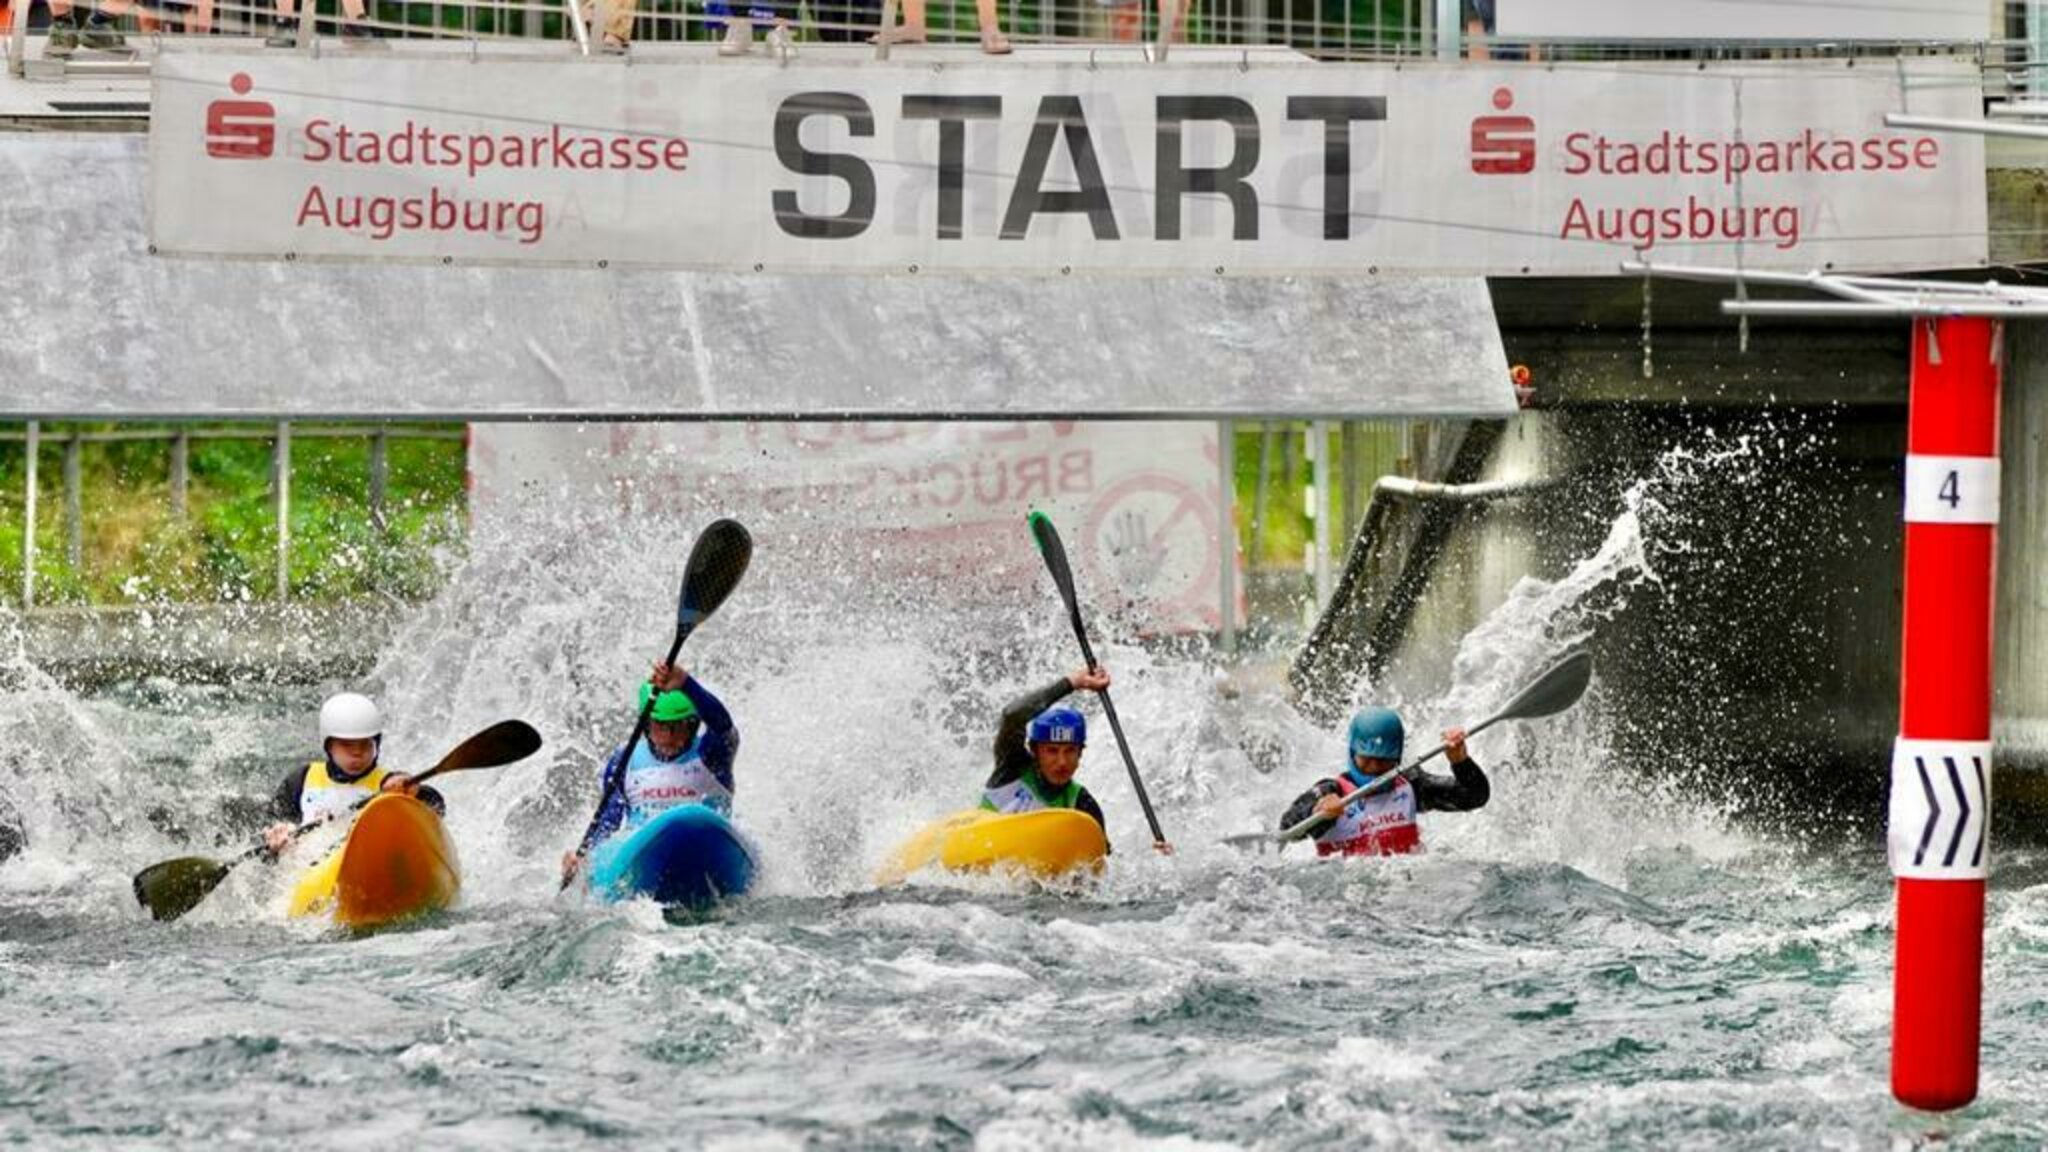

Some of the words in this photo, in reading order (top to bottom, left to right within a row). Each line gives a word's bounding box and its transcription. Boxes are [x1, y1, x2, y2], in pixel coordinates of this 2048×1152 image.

[302, 118, 689, 177] Stadtsparkasse
[772, 91, 1387, 240] START
[1564, 129, 1940, 184] Stadtsparkasse
[296, 185, 545, 243] Augsburg
[1560, 197, 1799, 251] Augsburg
[1938, 470, 1961, 509] 4
[642, 786, 697, 799] KUKA
